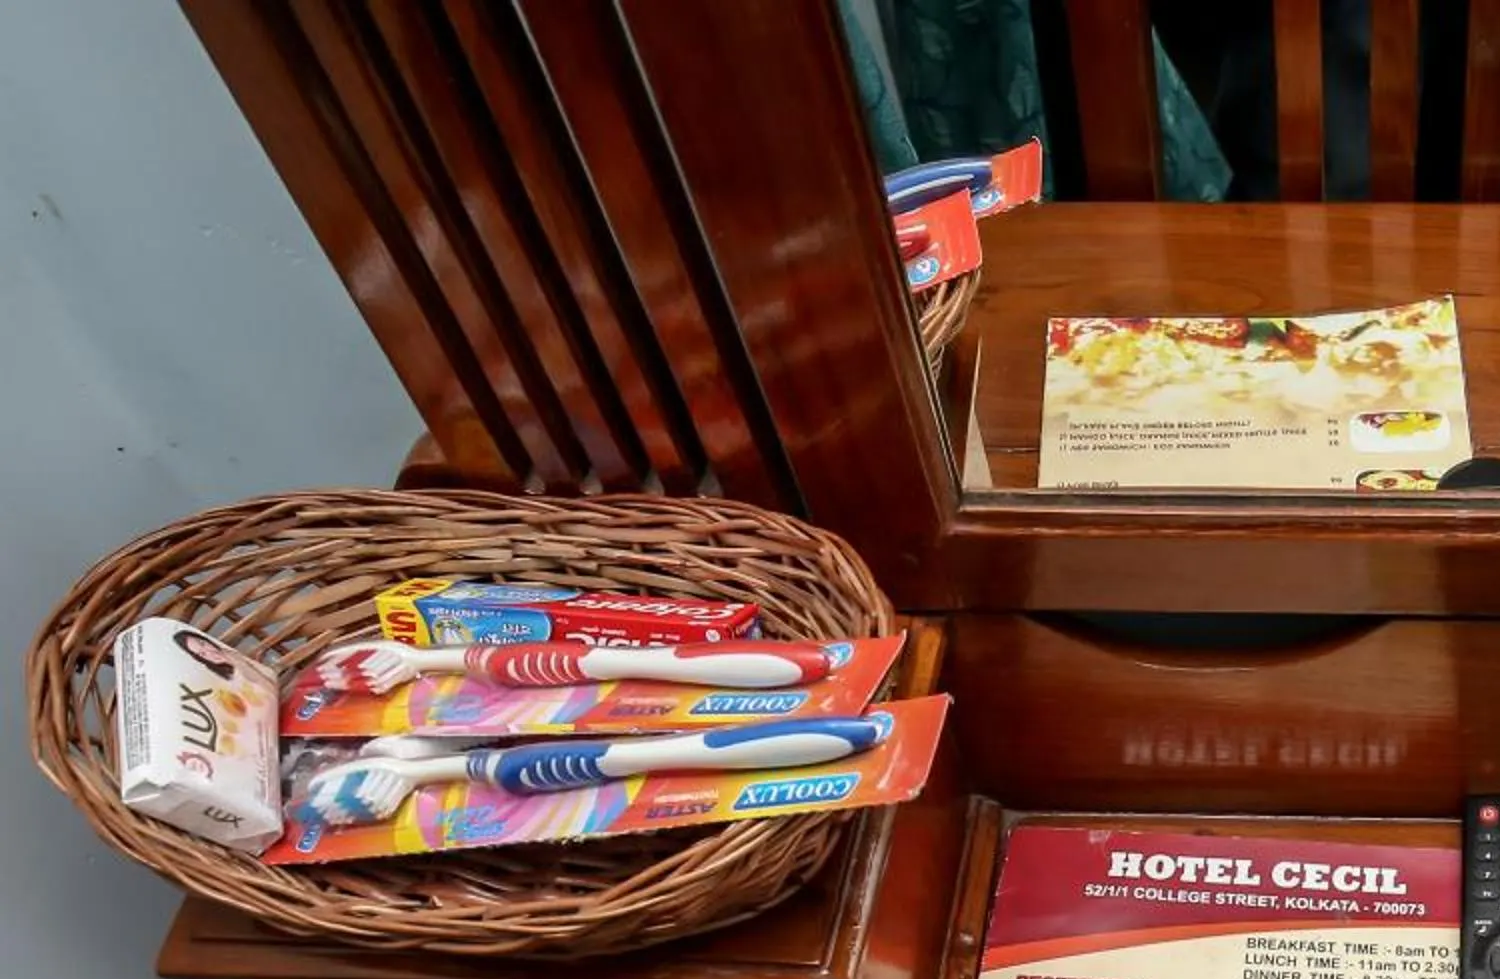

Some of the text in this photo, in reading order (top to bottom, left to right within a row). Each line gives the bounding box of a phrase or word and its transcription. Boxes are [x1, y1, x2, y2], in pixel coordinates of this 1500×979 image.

[607, 704, 677, 716] ASTER
[697, 695, 798, 714] COOLUX
[178, 682, 218, 752] LUX
[741, 779, 850, 806] COOLUX
[203, 805, 245, 829] LUX
[645, 802, 718, 819] ASTER
[1108, 852, 1407, 894] HOTEL CECIL
[1084, 883, 1425, 916] 52/1/1 COLLEGE STREET, KOLKATA 700073
[1247, 938, 1337, 954] BREAKFAST
[1344, 943, 1378, 956] TIME
[1429, 946, 1449, 958] TO
[1245, 954, 1421, 972] LUNCH TIME 11am TO
